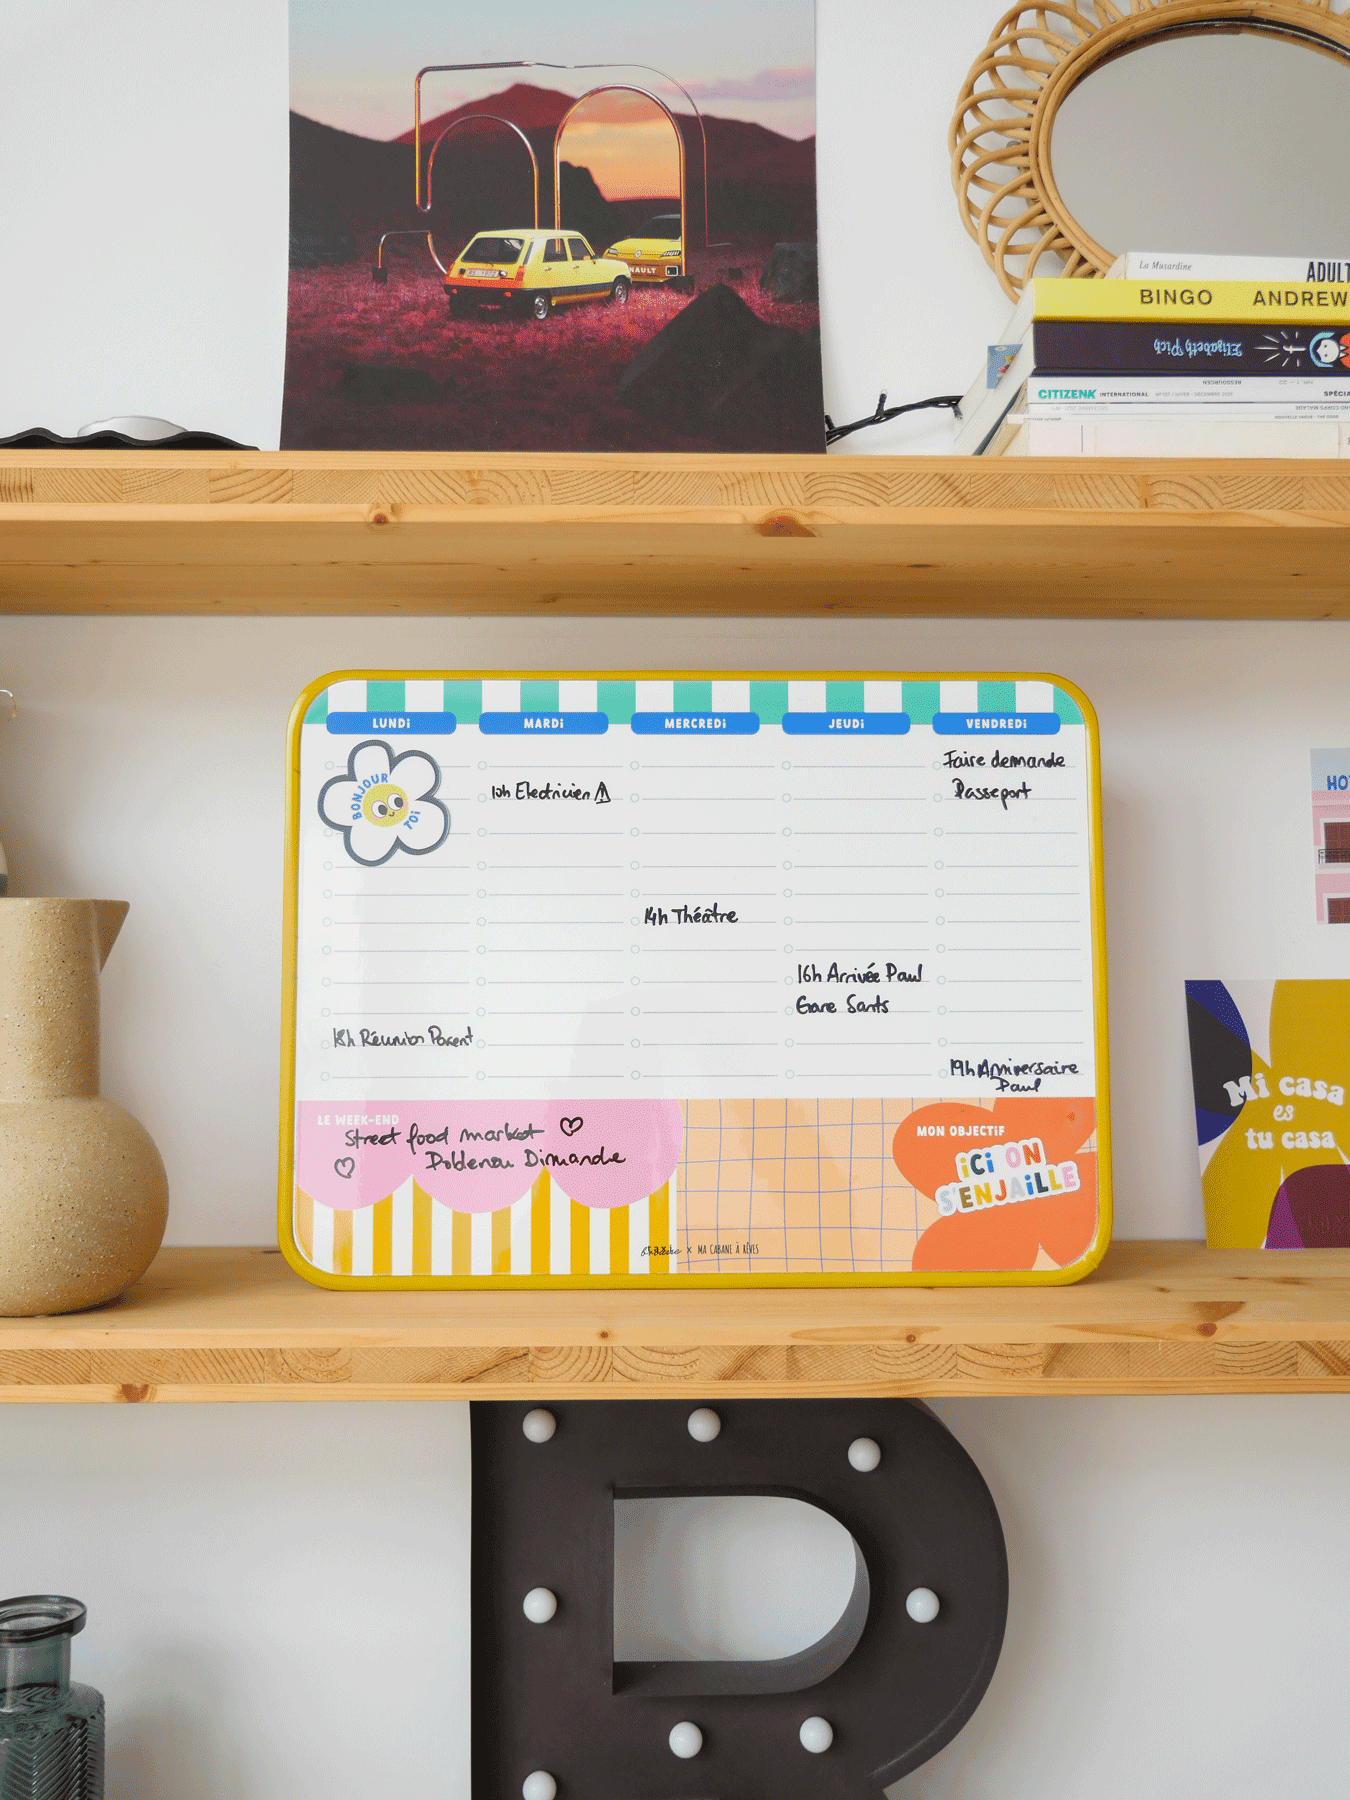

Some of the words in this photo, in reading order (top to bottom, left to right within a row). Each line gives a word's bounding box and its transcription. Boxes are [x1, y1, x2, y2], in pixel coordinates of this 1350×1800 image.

[1138, 261, 1149, 270] La
[1151, 262, 1192, 272] Musardine
[1140, 288, 1213, 306] BINGO
[1253, 289, 1349, 308] ANDREW
[1153, 338, 1183, 357] Pich
[1185, 338, 1243, 359] Elizabeth
[1038, 389, 1097, 400] CITIZENK
[943, 749, 986, 769] Faire
[991, 749, 1066, 769] demande
[1327, 775, 1350, 790] HO
[350, 773, 388, 820] BONJOUR
[952, 777, 1032, 811] Passeport
[671, 902, 739, 925] Théâtre
[798, 963, 822, 984] 16h
[827, 961, 881, 984] Arrivée
[886, 962, 923, 983] Paul
[795, 994, 837, 1015] Gare
[846, 993, 890, 1014] Sants
[359, 1027, 425, 1047] Réunion
[428, 1024, 473, 1047] Parent
[977, 1058, 1080, 1078] Anniversaire
[990, 1076, 1041, 1092] Paul
[1223, 1072, 1270, 1107] Mi
[1278, 1076, 1345, 1106] casa
[317, 1115, 332, 1126] LE
[335, 1114, 399, 1126] WEEK-END
[1273, 1104, 1294, 1121] es
[406, 1122, 449, 1156] food
[917, 1125, 945, 1137] MON
[1245, 1127, 1274, 1149] tu
[1281, 1130, 1336, 1149] casa
[1005, 1142, 1042, 1169] ON
[697, 1244, 707, 1254] MA
[709, 1244, 733, 1254] CABANE
[735, 1241, 741, 1254] À
[743, 1241, 760, 1254] RÊVES
